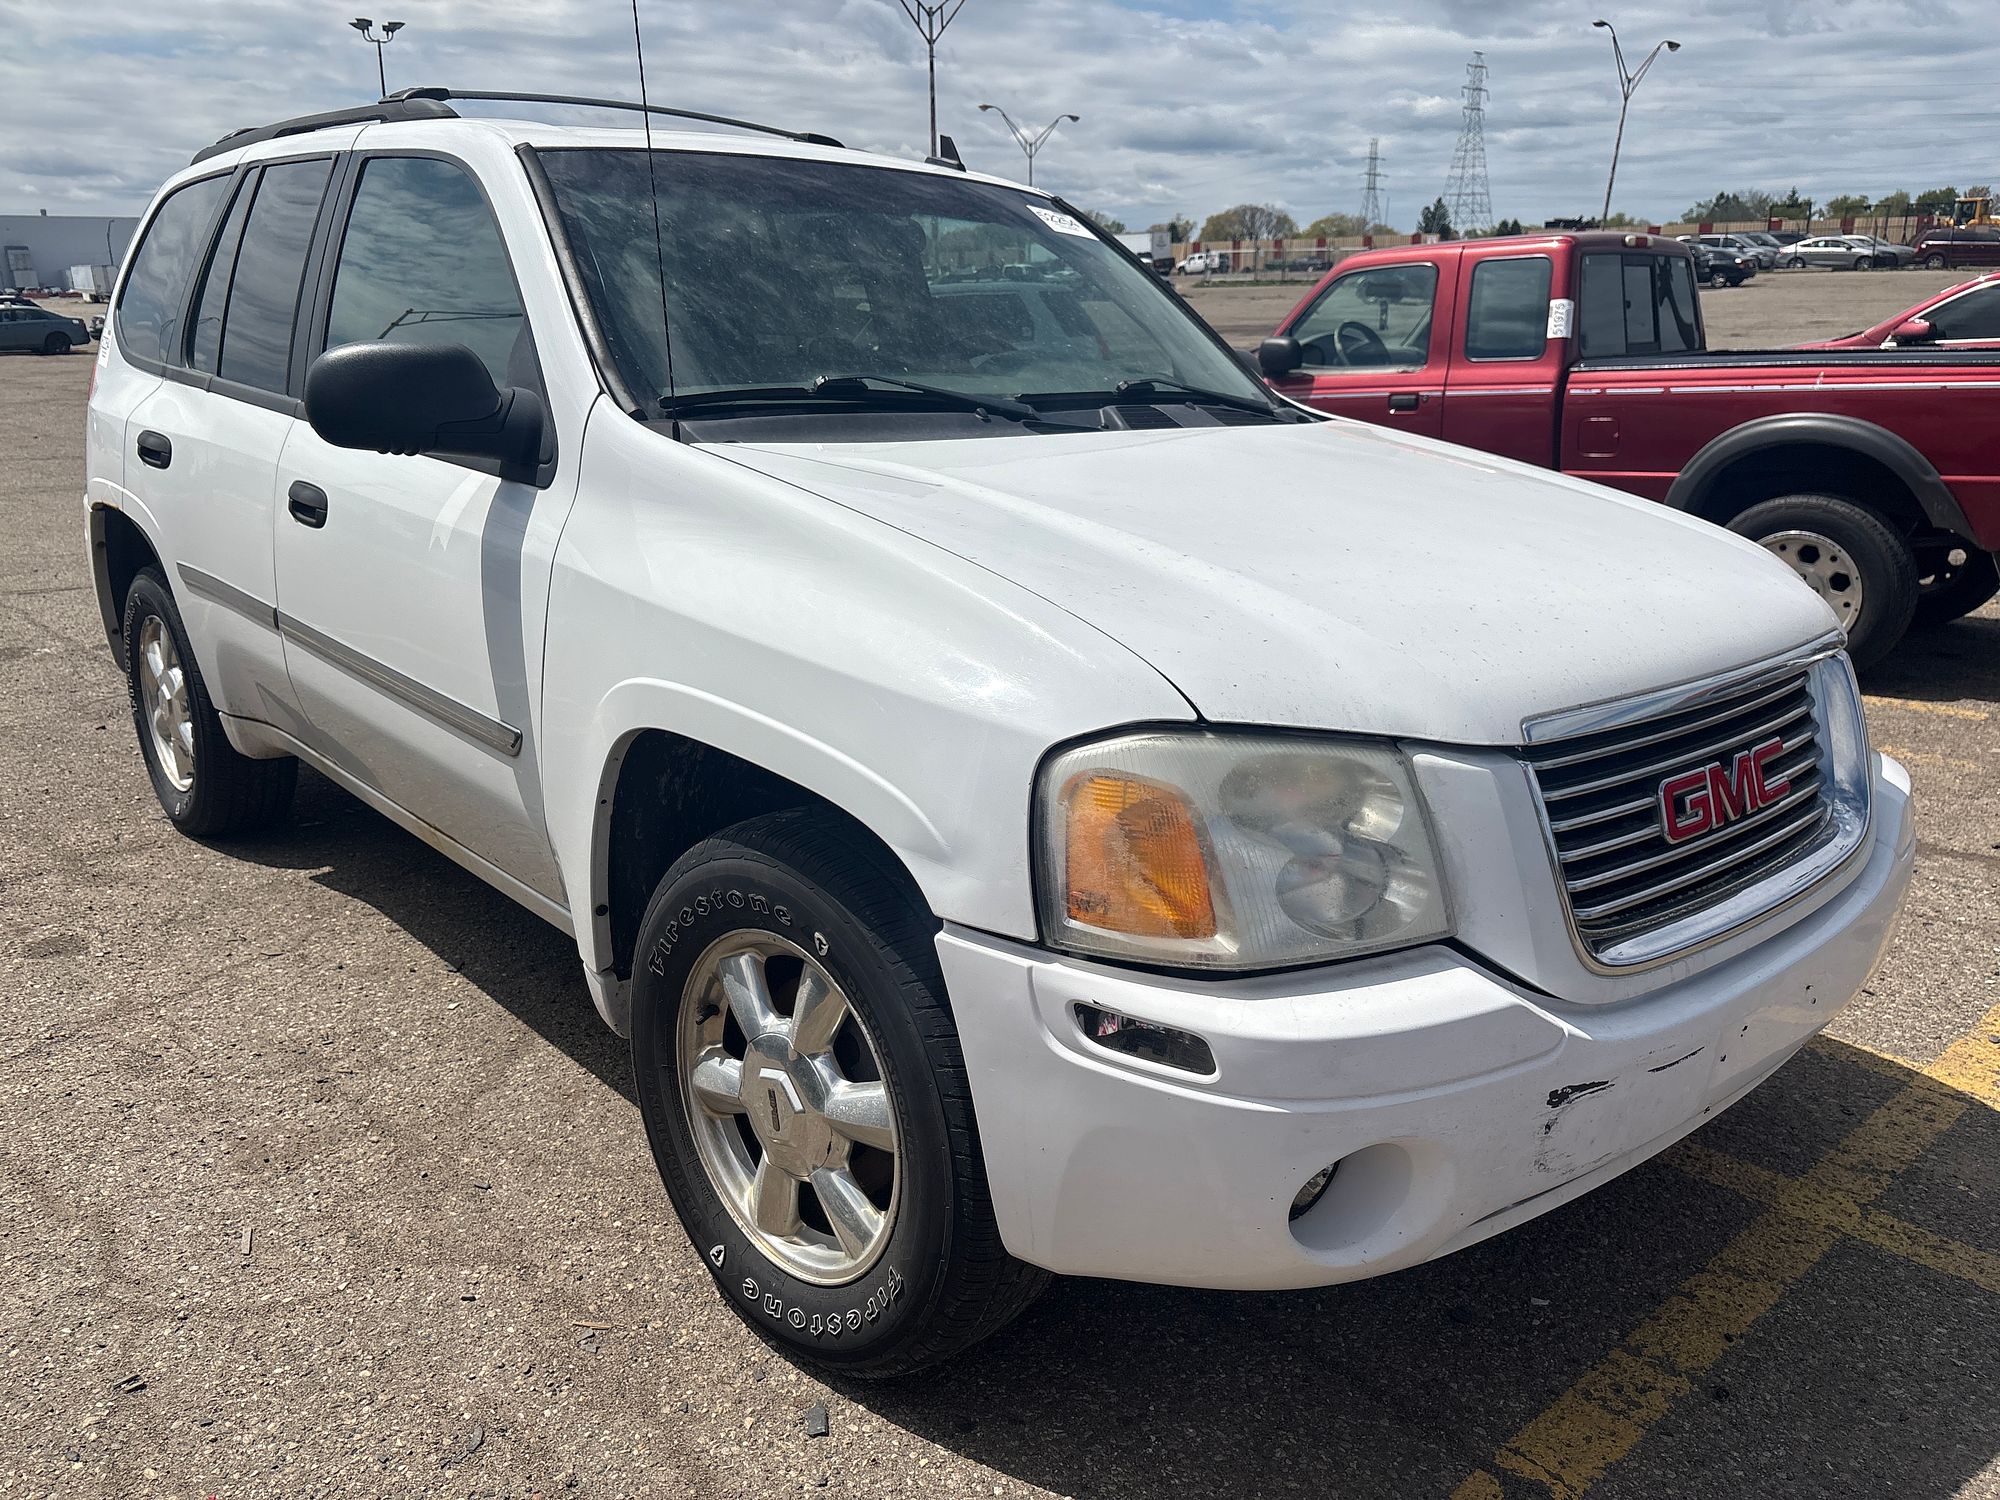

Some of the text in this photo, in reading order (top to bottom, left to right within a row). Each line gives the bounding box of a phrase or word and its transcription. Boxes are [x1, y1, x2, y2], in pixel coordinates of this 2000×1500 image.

[1658, 736, 1791, 844] GMC
[648, 887, 792, 976] Firestone
[742, 1265, 903, 1336] Firestone
